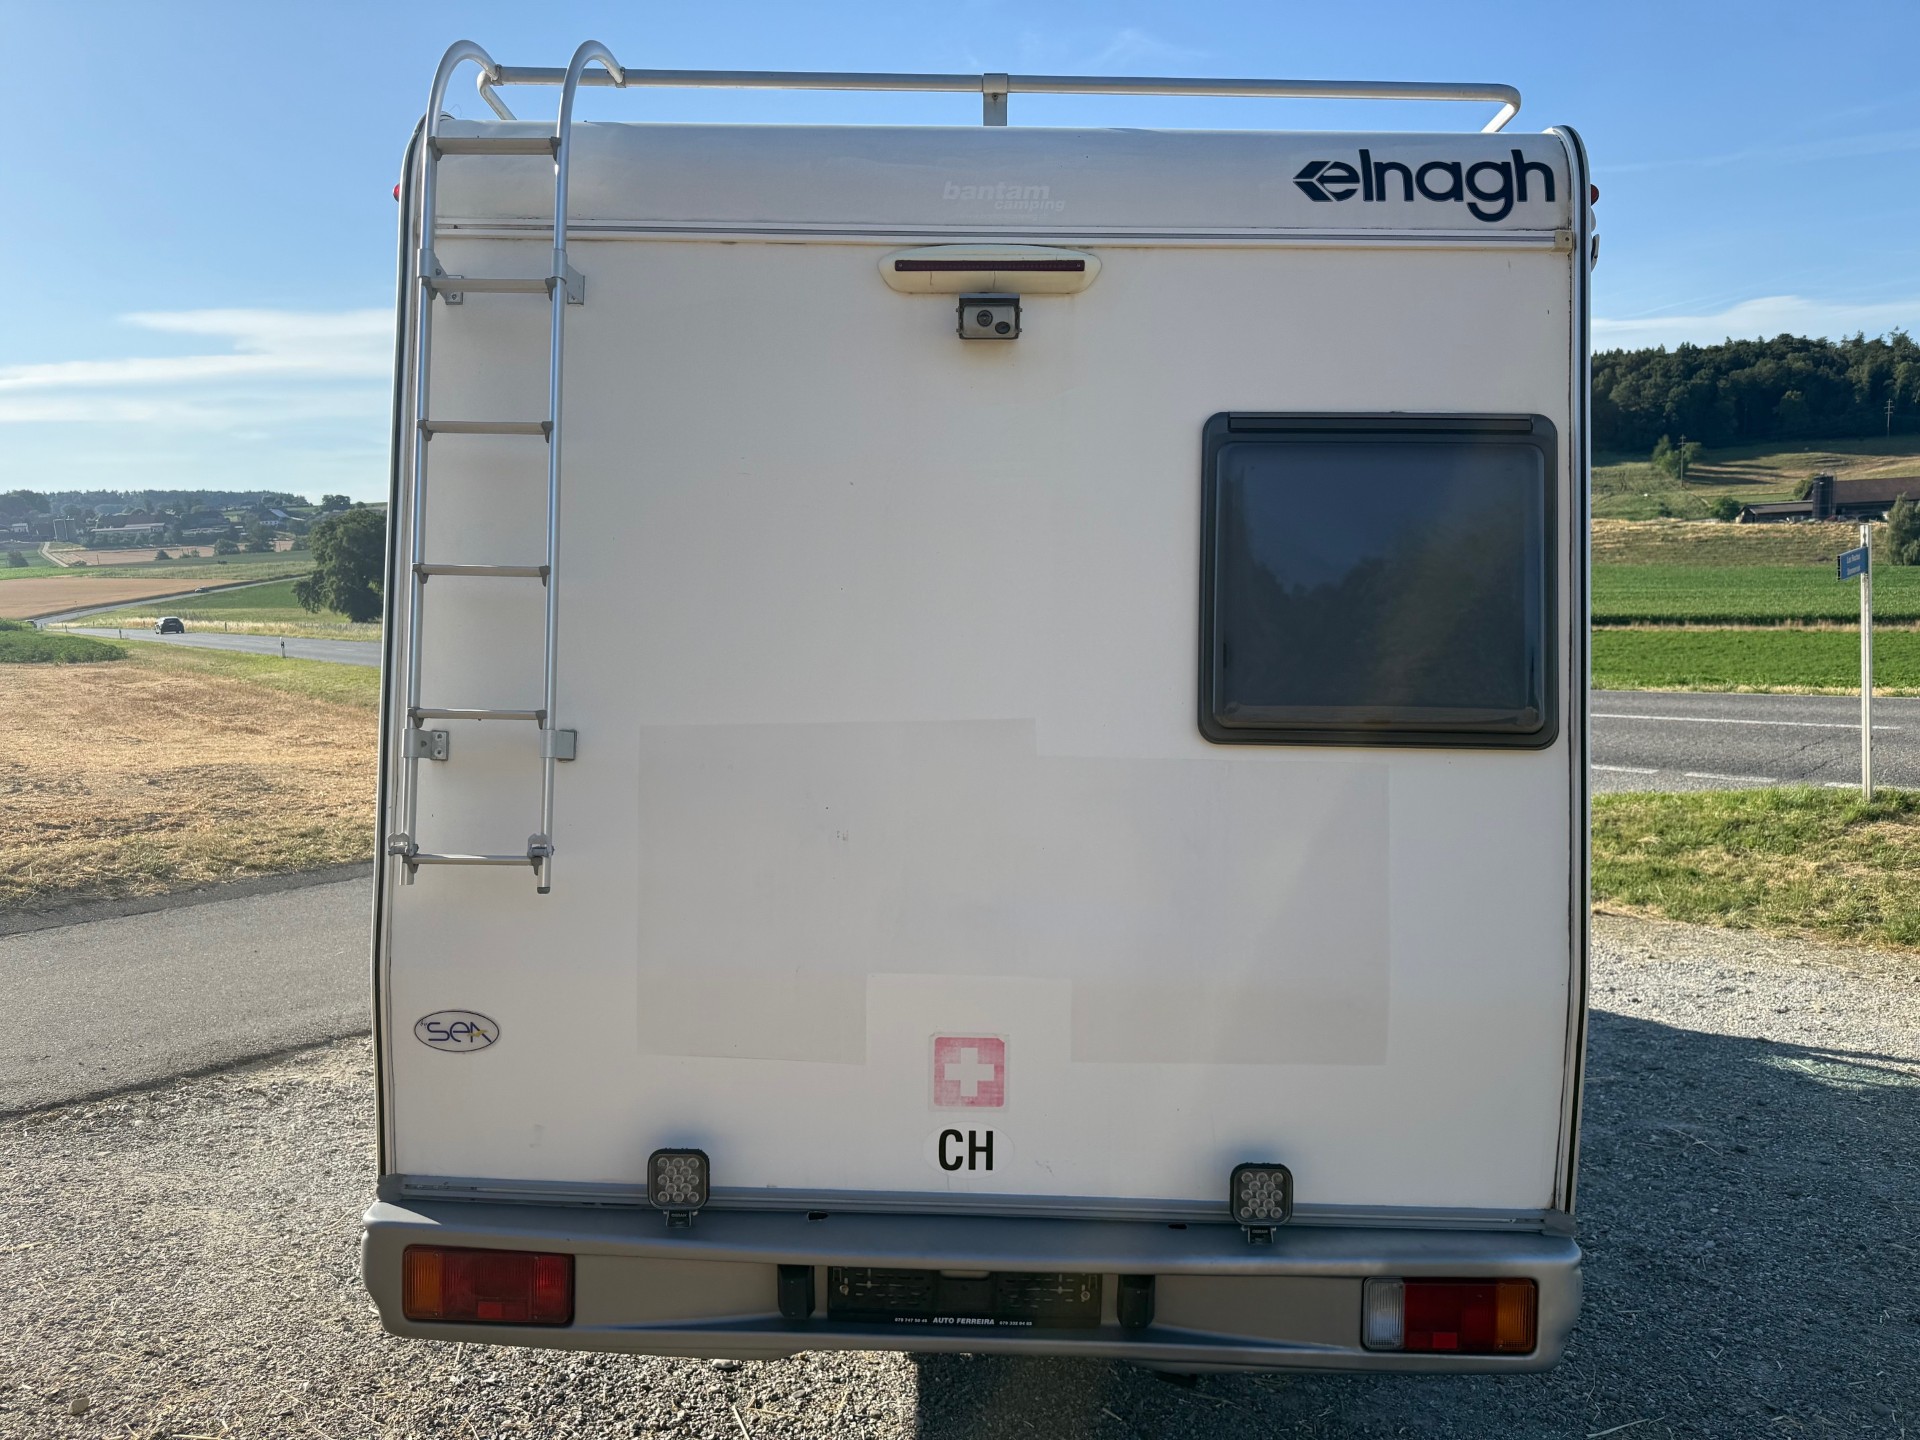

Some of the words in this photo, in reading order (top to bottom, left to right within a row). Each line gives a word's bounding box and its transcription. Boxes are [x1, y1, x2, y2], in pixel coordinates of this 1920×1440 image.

[942, 181, 1050, 200] bantam
[1315, 149, 1556, 222] elnagh
[994, 200, 1066, 211] camping
[939, 1129, 993, 1171] CH
